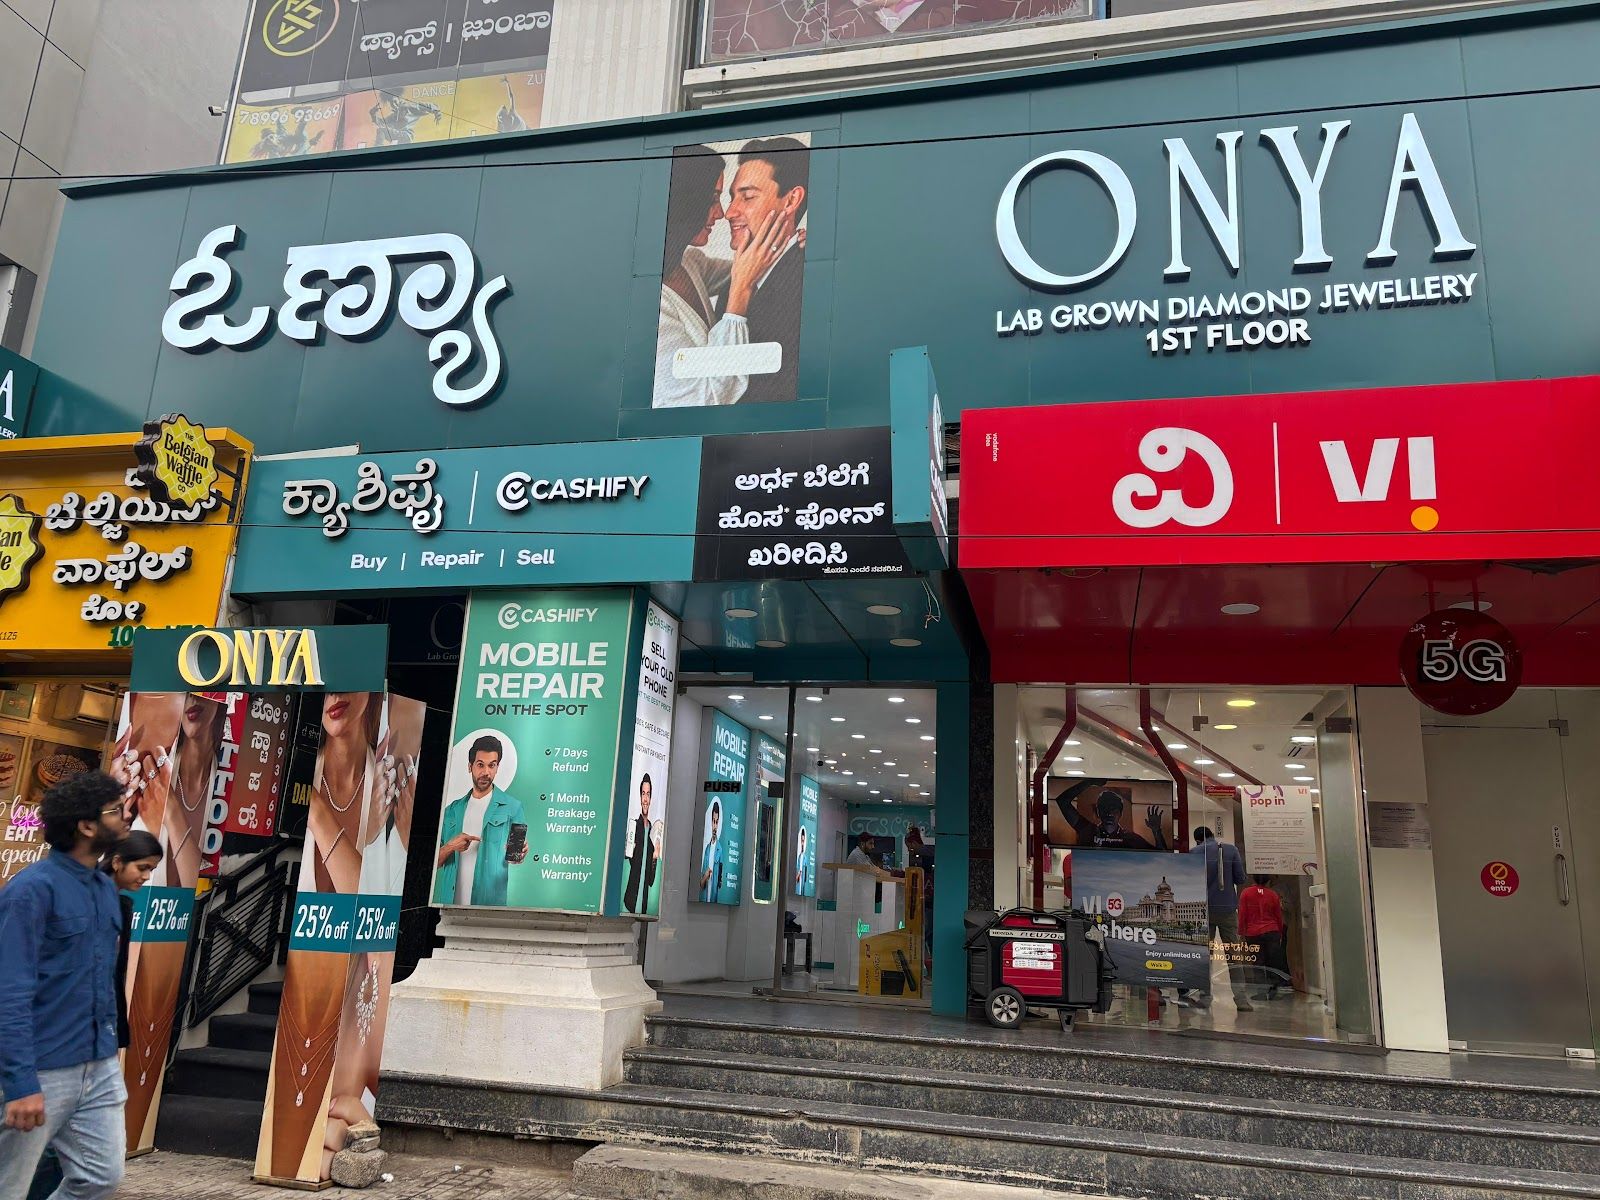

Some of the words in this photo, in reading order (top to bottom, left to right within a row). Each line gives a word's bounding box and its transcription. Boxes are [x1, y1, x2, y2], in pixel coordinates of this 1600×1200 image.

[411, 82, 455, 98] DANCE
[527, 74, 545, 86] ZU
[239, 107, 289, 126] 78996
[293, 104, 340, 123] 93669
[995, 111, 1477, 286] ONYA
[996, 308, 1043, 334] LAB
[1050, 298, 1160, 330] GROWN
[1168, 286, 1311, 321] DIAMOND
[1318, 273, 1478, 309] JEWELLERY
[1146, 325, 1198, 353] 1ST
[1207, 318, 1311, 350] FLOOR
[185, 432, 194, 441] THE
[164, 433, 209, 469] Belgian
[166, 453, 203, 488] Waffle
[803, 462, 870, 488] ಬೆಲೆಗೆ
[1111, 427, 1235, 529] ವಿ
[177, 484, 186, 492] CO
[530, 475, 650, 501] CASHIFY
[795, 501, 886, 530] ಫೋನ್
[0, 529, 22, 547] an
[350, 553, 388, 572] Buy
[420, 549, 484, 570] Repair
[516, 549, 555, 565] Sell
[521, 607, 599, 623] CASHIFY
[108, 624, 147, 647] 10
[178, 628, 325, 687] ONYA
[427, 652, 441, 660] Lab
[478, 642, 609, 667] MOBILE
[651, 641, 666, 660] SELL
[1422, 639, 1507, 682] 5G
[661, 666, 674, 683] OLD
[475, 672, 605, 699] REPAIR
[644, 676, 668, 698] PHONE
[484, 704, 508, 716] ON
[511, 704, 540, 716] THE
[545, 704, 588, 716] SPOT
[715, 724, 747, 759] MOBILE
[554, 748, 561, 758] 7
[562, 748, 588, 760] Days
[203, 692, 244, 855] TATTOO
[552, 762, 589, 772] Refund
[713, 751, 745, 785] REPAIR
[704, 781, 741, 792] PUSH
[802, 784, 818, 799] MOBILE
[549, 793, 554, 803] 1
[556, 793, 590, 803] Month
[801, 798, 817, 816] REPAIR
[1250, 798, 1272, 808] pop
[1274, 796, 1285, 806] in
[547, 808, 596, 820] Breakage
[5, 825, 39, 843] EAT.
[542, 854, 549, 864] 6
[551, 855, 591, 865] Months
[1490, 884, 1512, 893] entry
[147, 898, 179, 930] 25%
[176, 912, 190, 930] off
[1107, 898, 1122, 911] 5G
[131, 911, 141, 930] ff
[294, 904, 334, 938] 25%
[333, 921, 350, 940] off
[355, 906, 386, 940] 25%
[384, 921, 397, 940] off
[1111, 919, 1157, 945] here
[1145, 950, 1162, 959] Enjoy
[1162, 950, 1191, 959] unlimited
